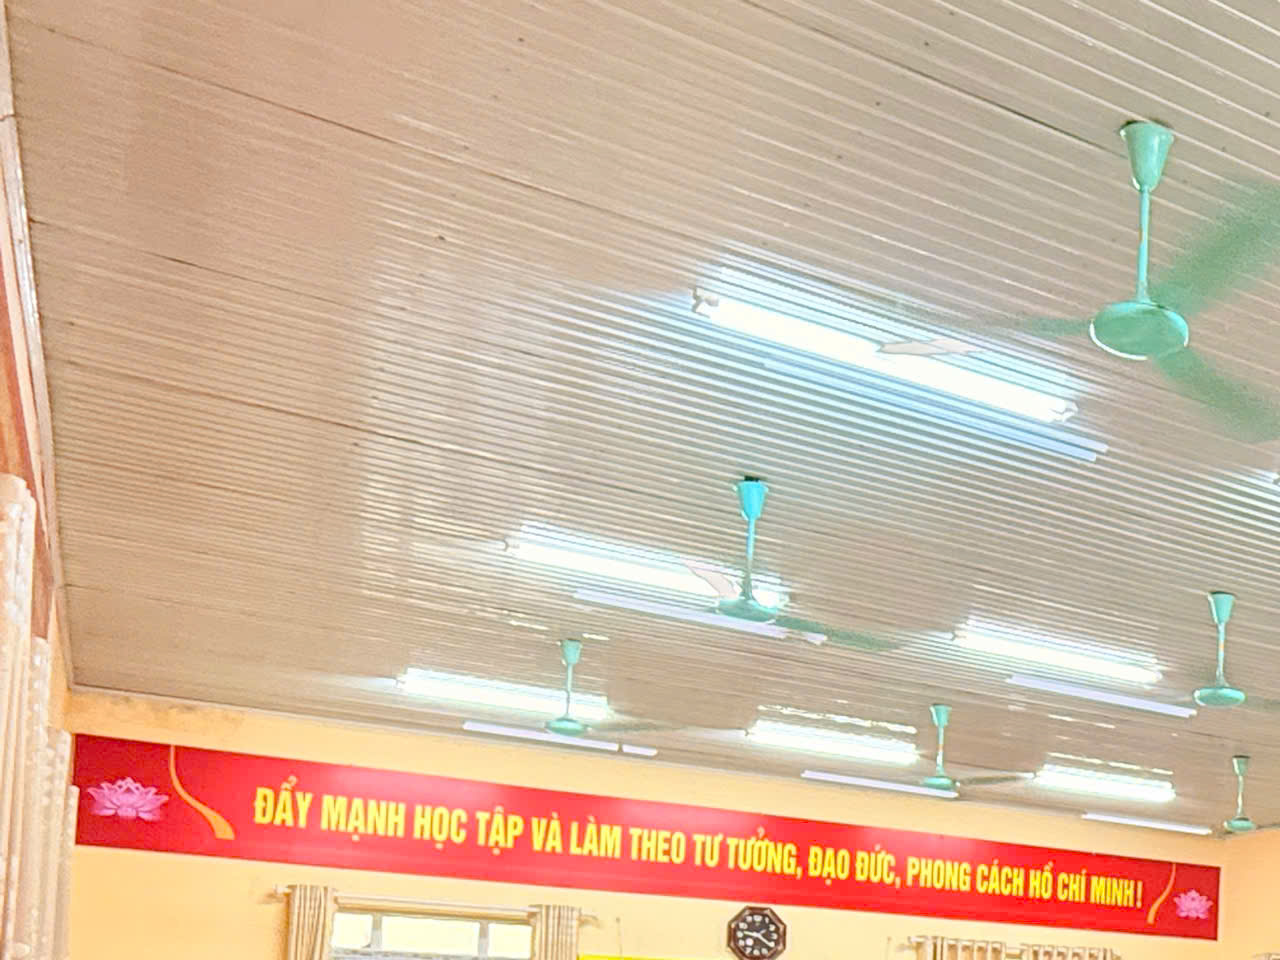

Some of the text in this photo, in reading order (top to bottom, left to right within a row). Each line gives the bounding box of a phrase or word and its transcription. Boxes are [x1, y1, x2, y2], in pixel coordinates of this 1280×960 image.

[253, 775, 312, 828] ĐẨY
[320, 794, 406, 842] MẠNH
[412, 803, 468, 850] HỌC
[475, 805, 525, 856] TẬP
[530, 811, 562, 854] VÀ
[569, 815, 622, 859] LÀM
[629, 826, 687, 865] THEO
[692, 832, 724, 868] TƯ
[726, 826, 802, 880] TƯỞNG,
[808, 845, 851, 886] ĐẠO
[855, 843, 901, 888] ĐỨC,
[906, 856, 972, 892] PHONG
[976, 859, 1025, 898] CÁCH
[1057, 869, 1087, 903] CHÍ
